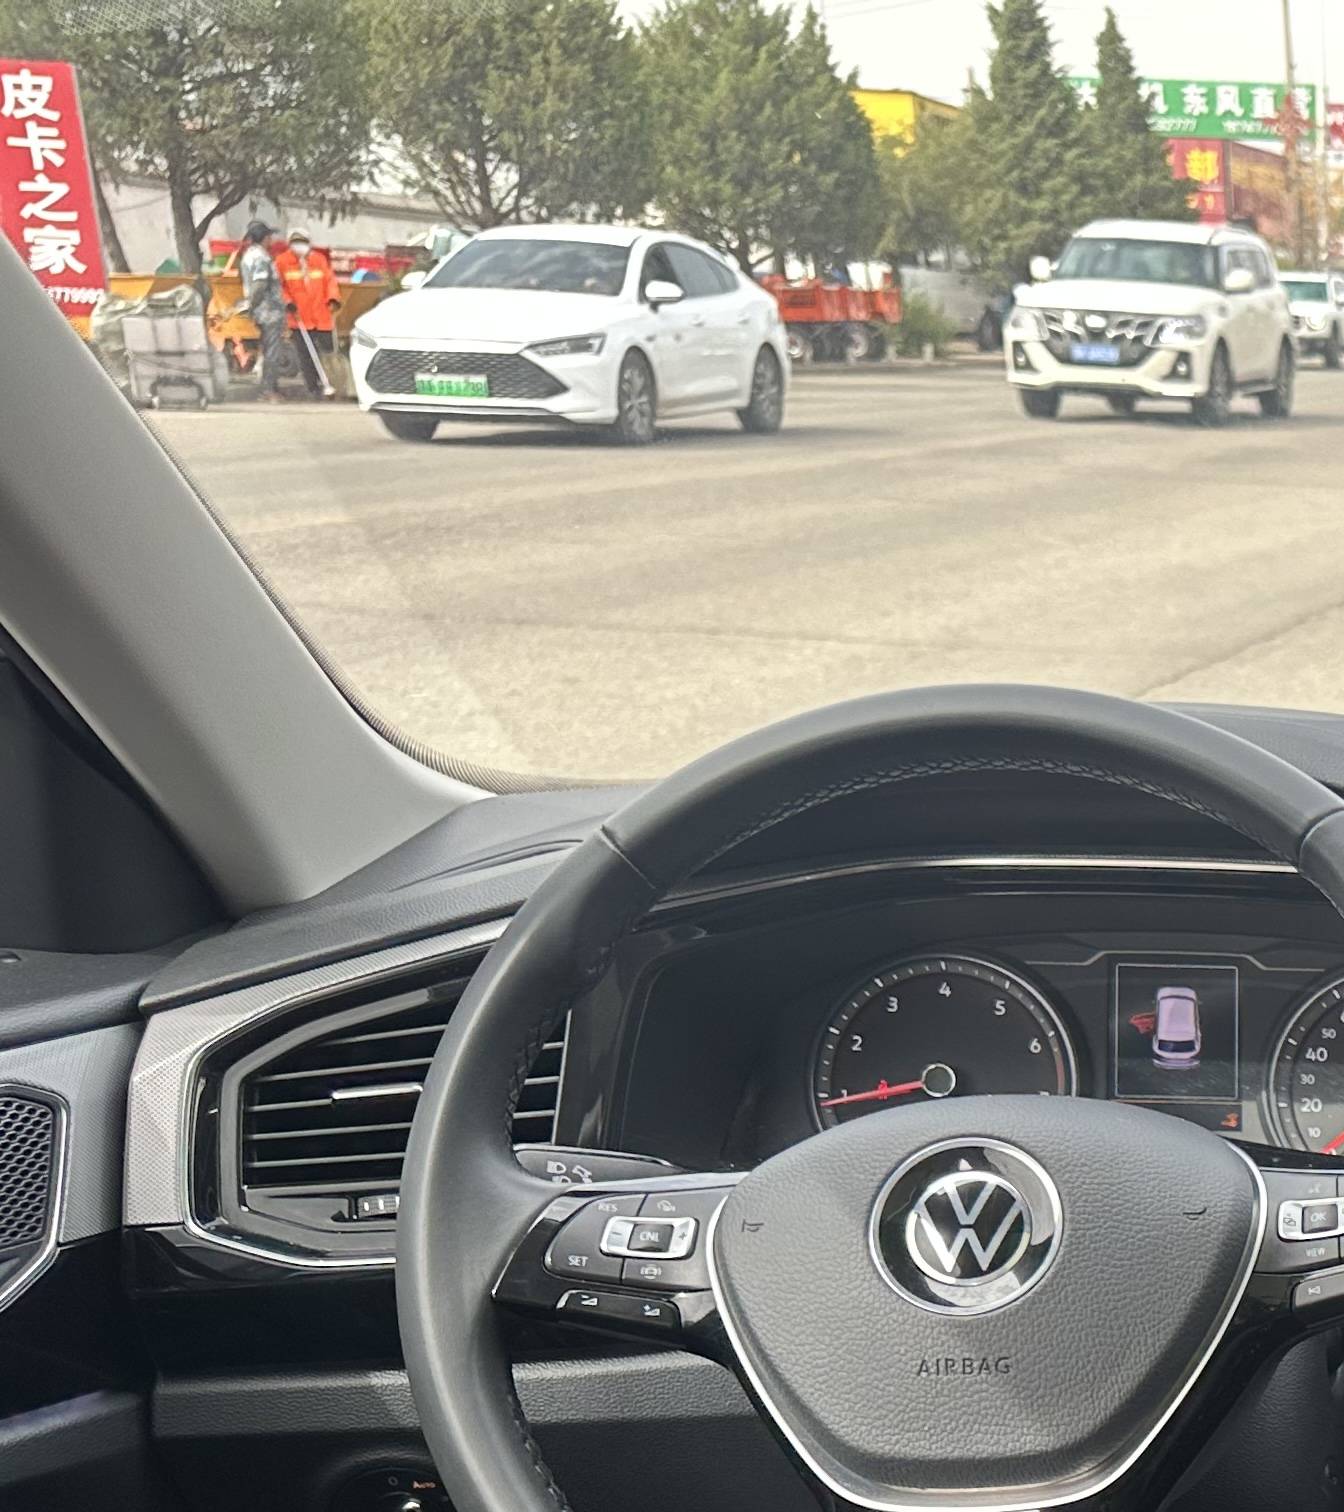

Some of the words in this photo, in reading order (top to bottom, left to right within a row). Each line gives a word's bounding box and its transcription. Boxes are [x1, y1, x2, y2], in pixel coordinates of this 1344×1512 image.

[1, 68, 88, 275] 皮卡之家
[938, 982, 951, 998] 4
[887, 997, 899, 1013] 3
[994, 1000, 1006, 1016] 5
[1321, 1028, 1337, 1040] 50
[851, 1035, 863, 1052] 2
[1029, 1038, 1042, 1053] 6
[1305, 1047, 1328, 1062] 40
[1300, 1074, 1315, 1085] 30
[1301, 1098, 1323, 1112] 20
[1307, 1127, 1321, 1138] 10
[1310, 1211, 1328, 1223] OK
[639, 1231, 660, 1242] CNL
[1306, 1247, 1326, 1257] VIEW
[567, 1255, 589, 1266] SET
[917, 1356, 1011, 1377] AIRBAG
